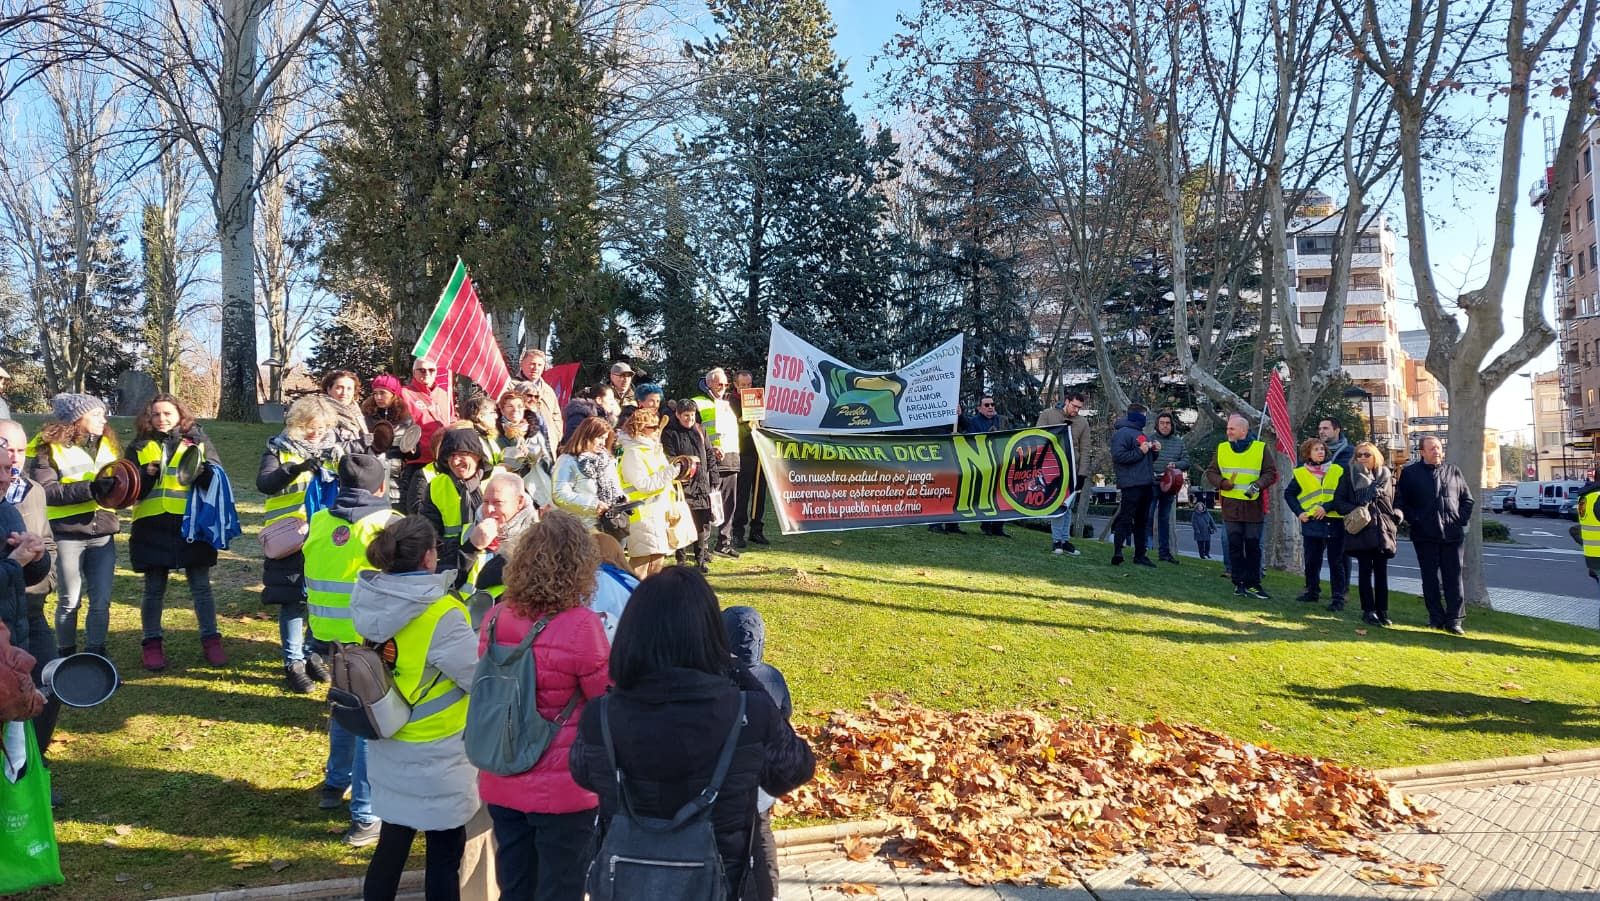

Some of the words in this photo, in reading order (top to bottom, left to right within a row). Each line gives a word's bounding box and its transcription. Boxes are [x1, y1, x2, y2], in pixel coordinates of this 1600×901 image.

[773, 353, 804, 382] STOP
[766, 385, 815, 416] BIOGÁS
[905, 392, 942, 403] VILLAMOR
[906, 400, 948, 413] ARGUJILLO
[908, 408, 959, 421] FUENTESPRE
[772, 441, 890, 463] JAMBRINA
[893, 444, 943, 462] DICE
[789, 471, 807, 482] Con
[808, 470, 847, 483] nuestra
[848, 470, 878, 482] salud
[879, 474, 892, 482] no
[893, 475, 905, 483] se
[905, 470, 934, 484] juega.
[783, 490, 831, 503] queremos
[831, 489, 848, 499] ser
[849, 486, 904, 499] estercolero
[906, 485, 918, 496] de
[920, 485, 953, 498] Europa.
[1024, 491, 1044, 506] NO
[802, 503, 813, 515] Ni
[814, 506, 827, 515] en
[828, 502, 838, 514] tu
[840, 502, 870, 517] pueblo
[871, 501, 881, 513] ni
[881, 504, 893, 512] en
[894, 500, 905, 512] el
